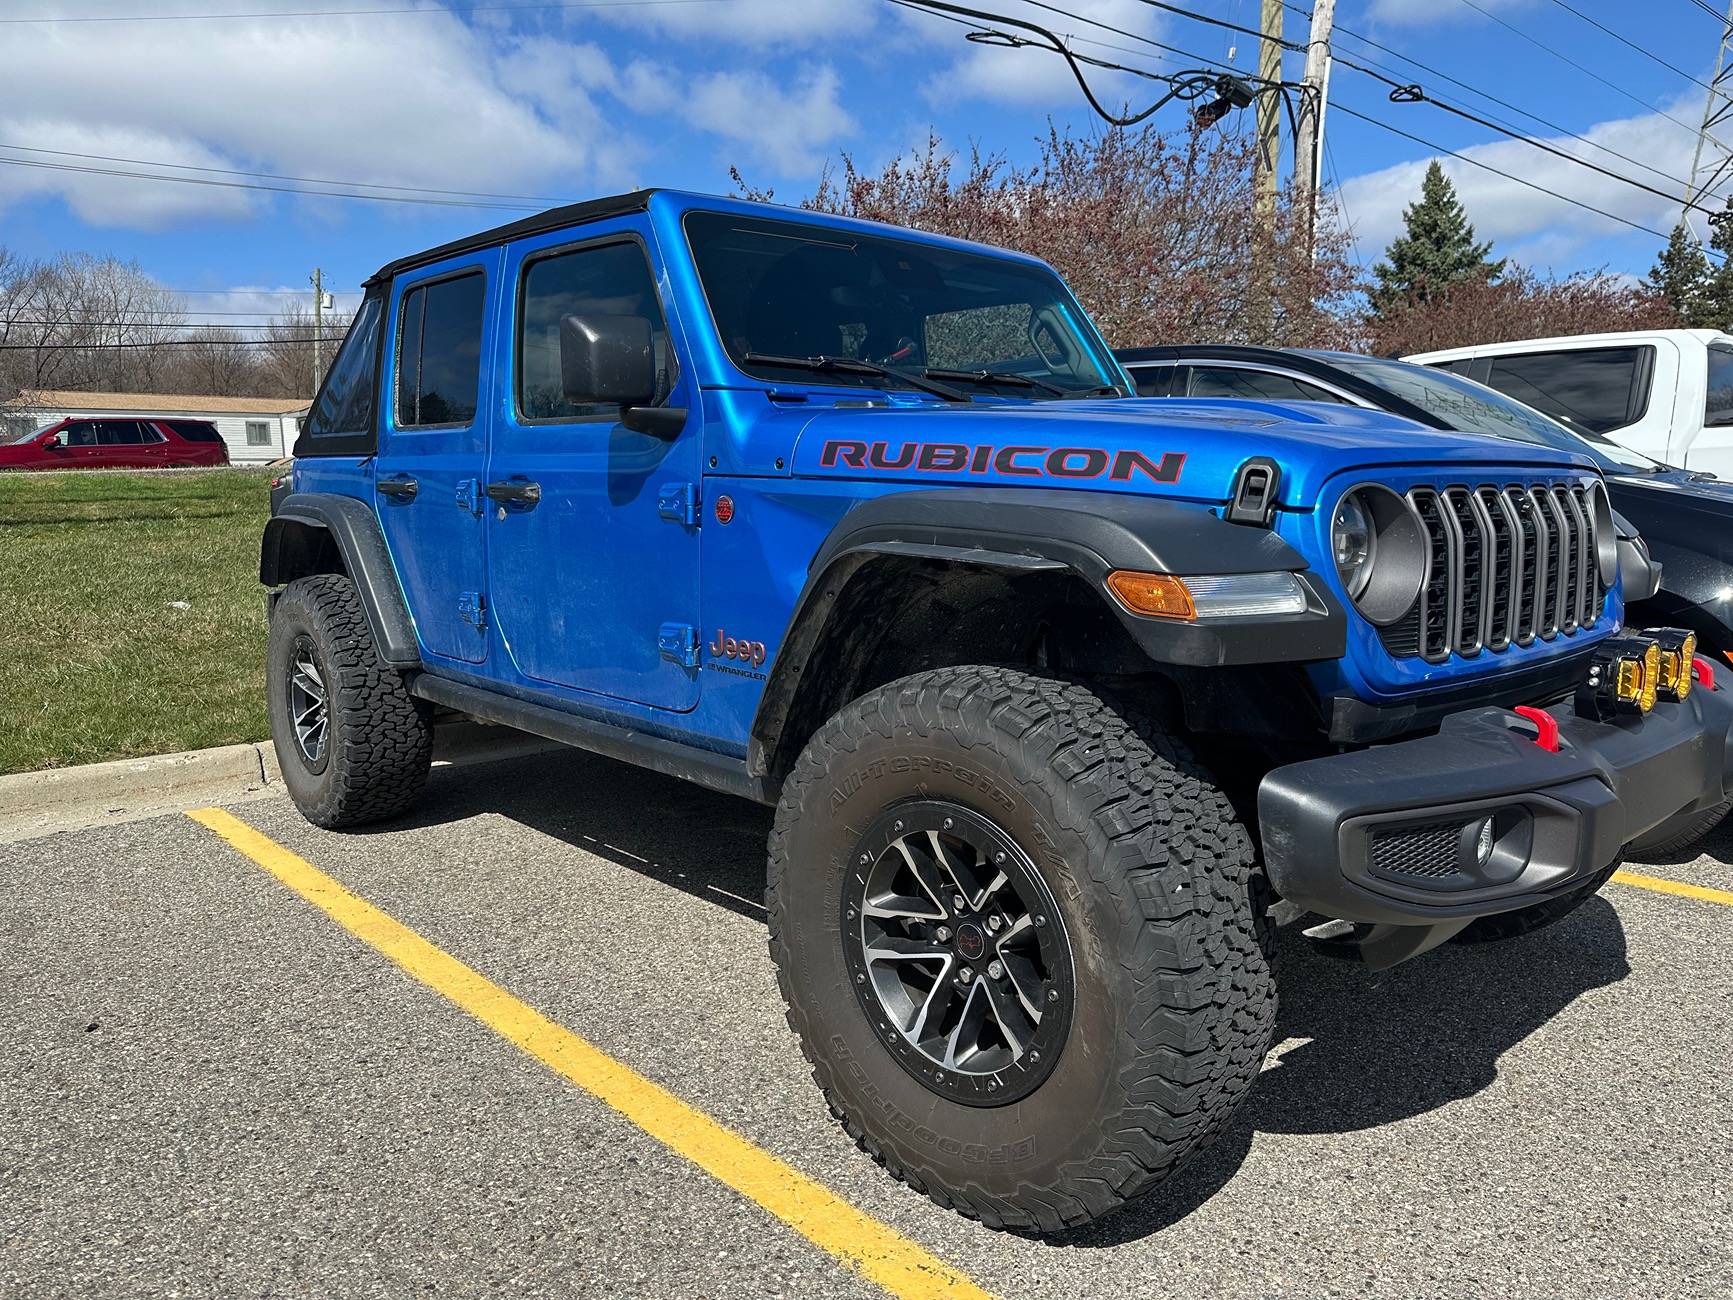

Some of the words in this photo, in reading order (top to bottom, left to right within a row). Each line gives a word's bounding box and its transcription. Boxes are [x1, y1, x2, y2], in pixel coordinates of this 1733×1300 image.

[820, 440, 1187, 483] RUBICON
[709, 629, 766, 670] Jeep
[715, 663, 767, 681] WRANGLER
